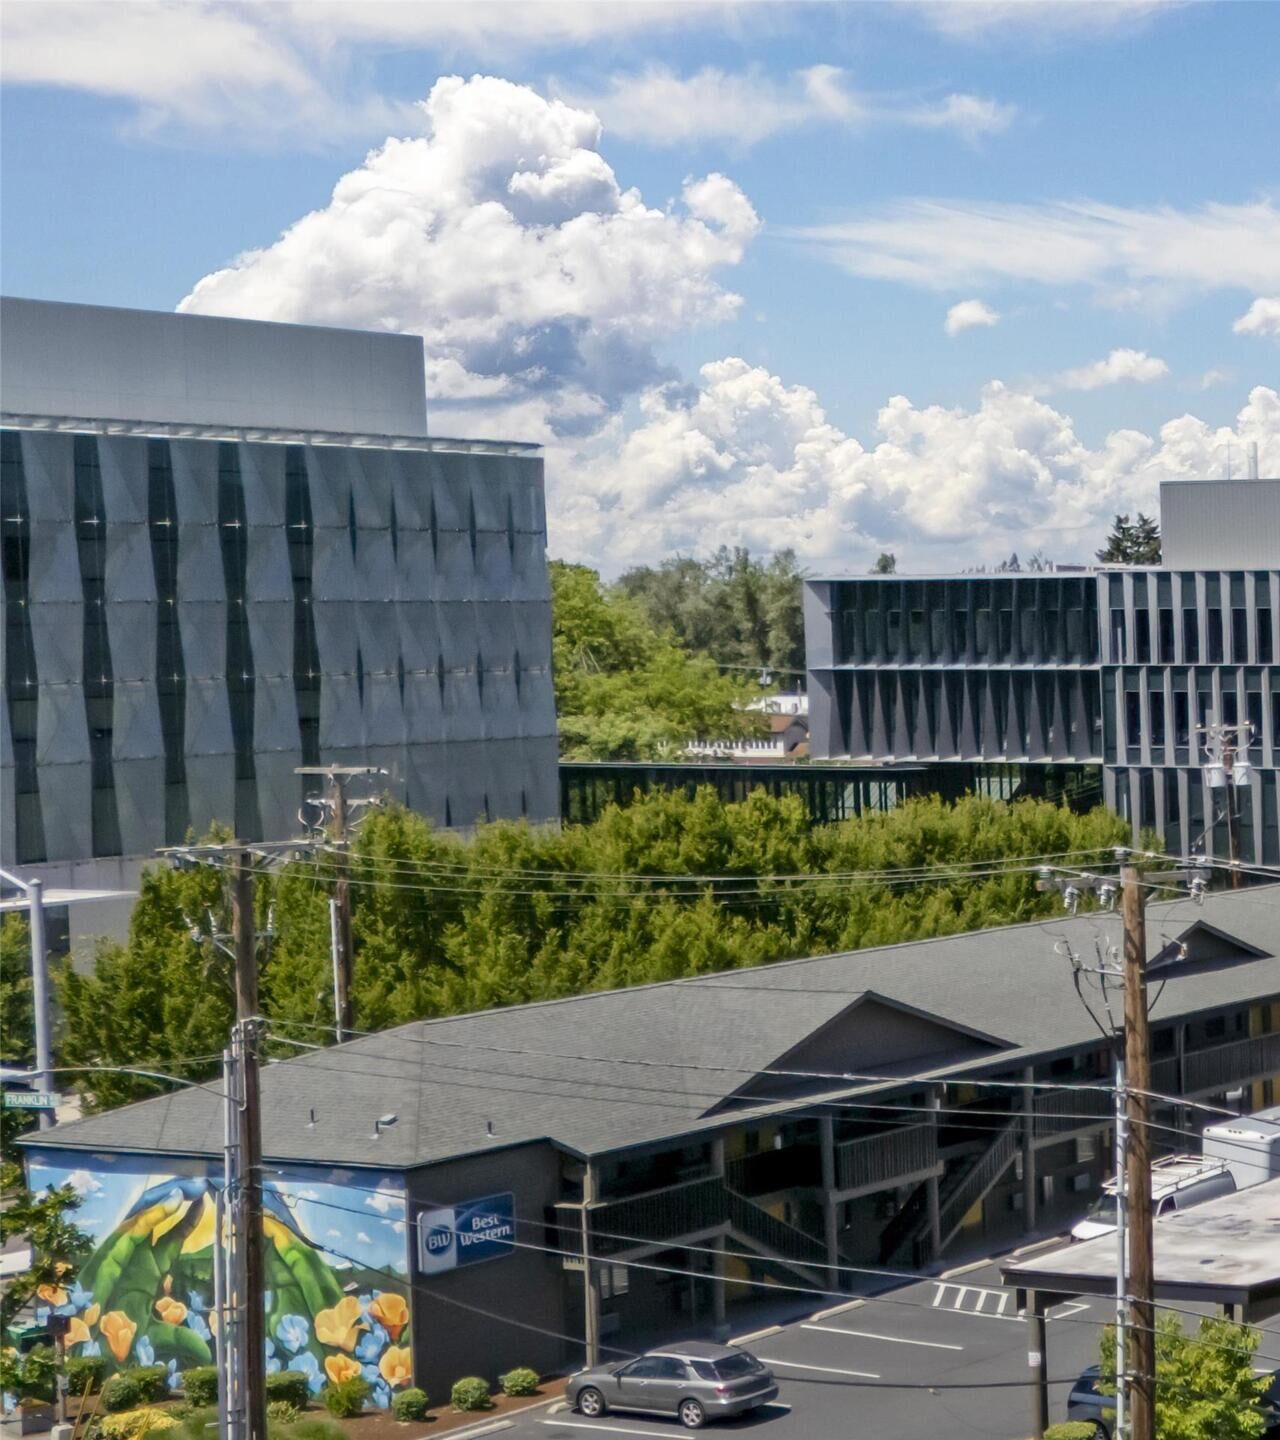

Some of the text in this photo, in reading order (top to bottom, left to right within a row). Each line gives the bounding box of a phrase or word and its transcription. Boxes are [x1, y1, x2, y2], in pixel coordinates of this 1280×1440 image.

[7, 1094, 48, 1105] FRANKLIN
[471, 1213, 500, 1231] Best
[428, 1232, 451, 1250] BW
[460, 1225, 511, 1247] Western
